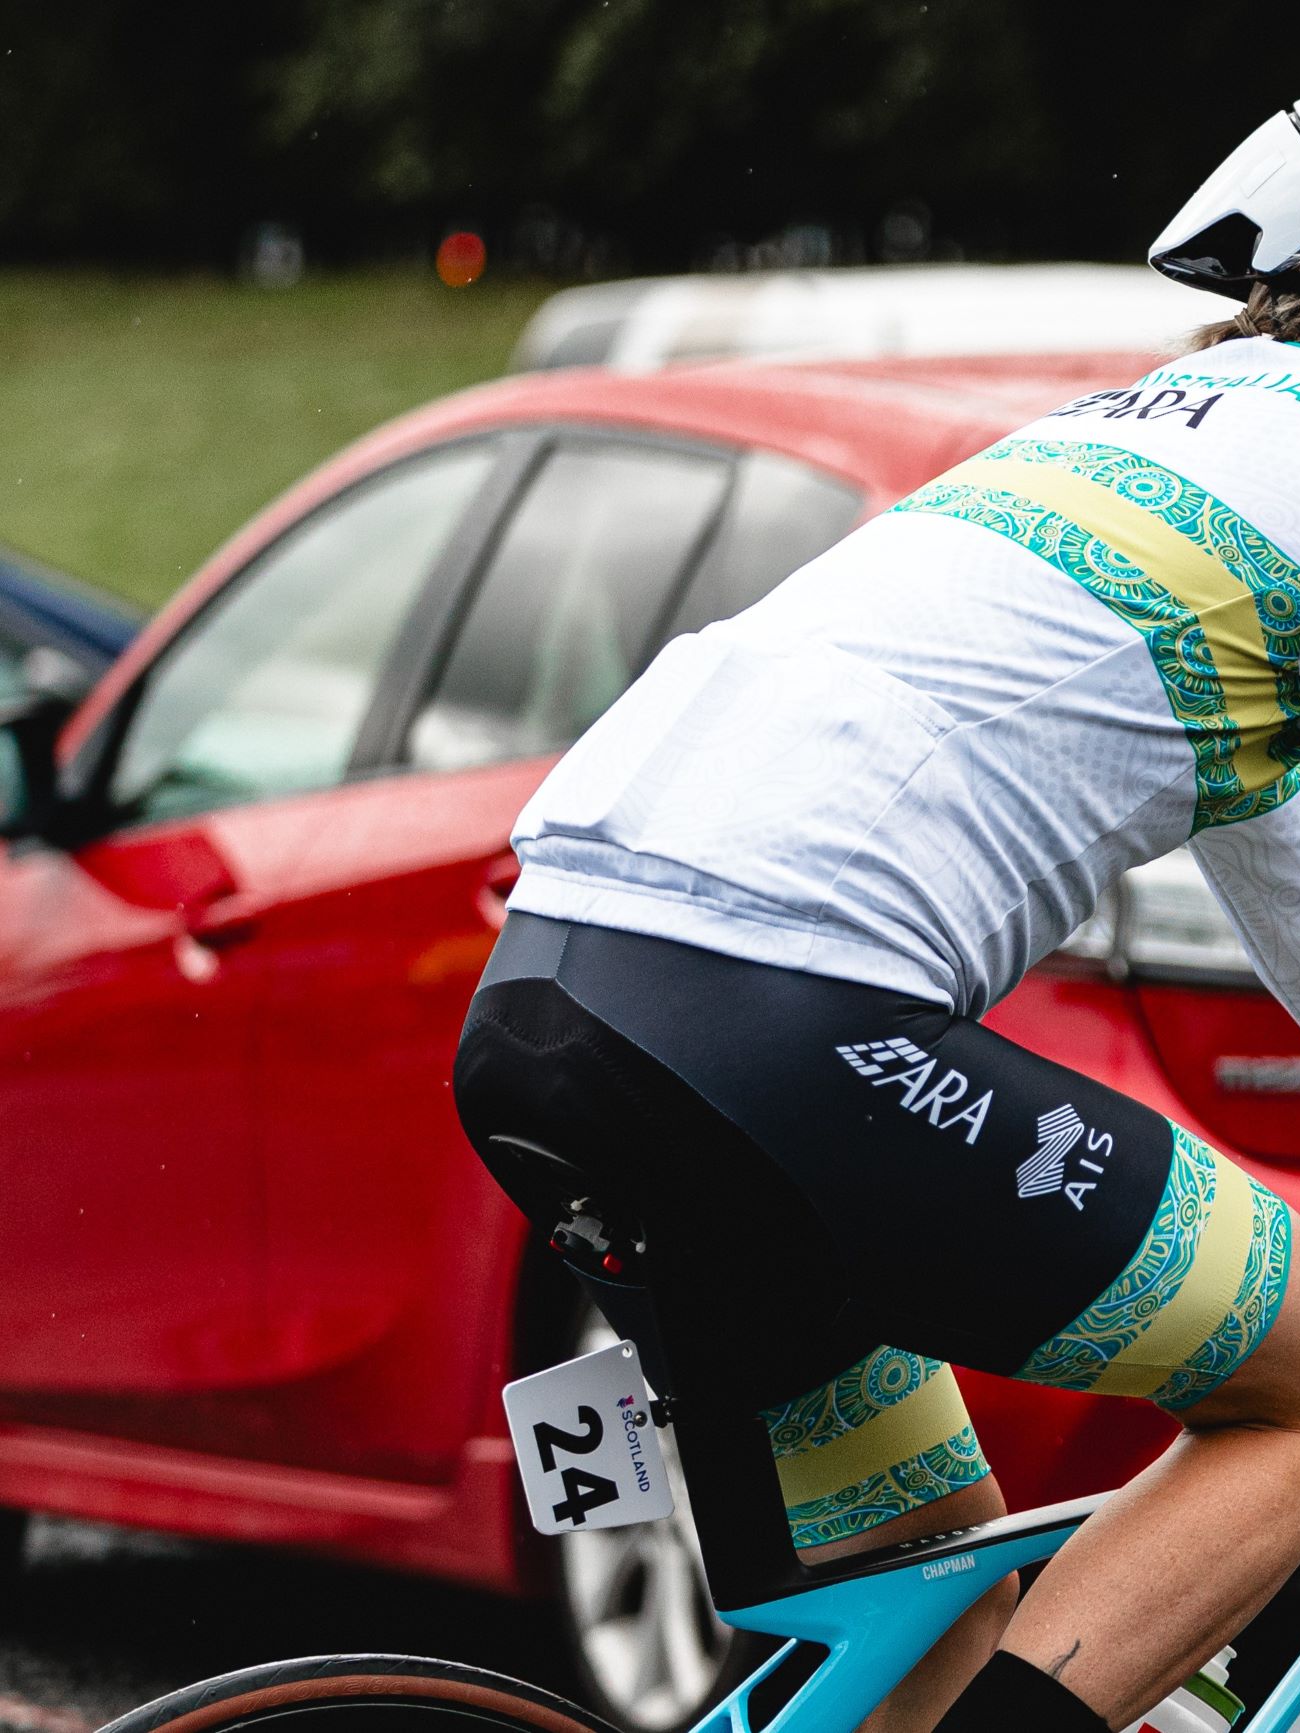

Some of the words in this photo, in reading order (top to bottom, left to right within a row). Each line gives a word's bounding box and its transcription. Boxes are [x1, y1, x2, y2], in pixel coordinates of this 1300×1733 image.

[871, 1058, 994, 1145] ARA
[1064, 1127, 1113, 1212] AIS
[532, 1405, 620, 1526] 24
[621, 1410, 650, 1493] SCOTLAND
[922, 1554, 976, 1581] CHAPMAN
